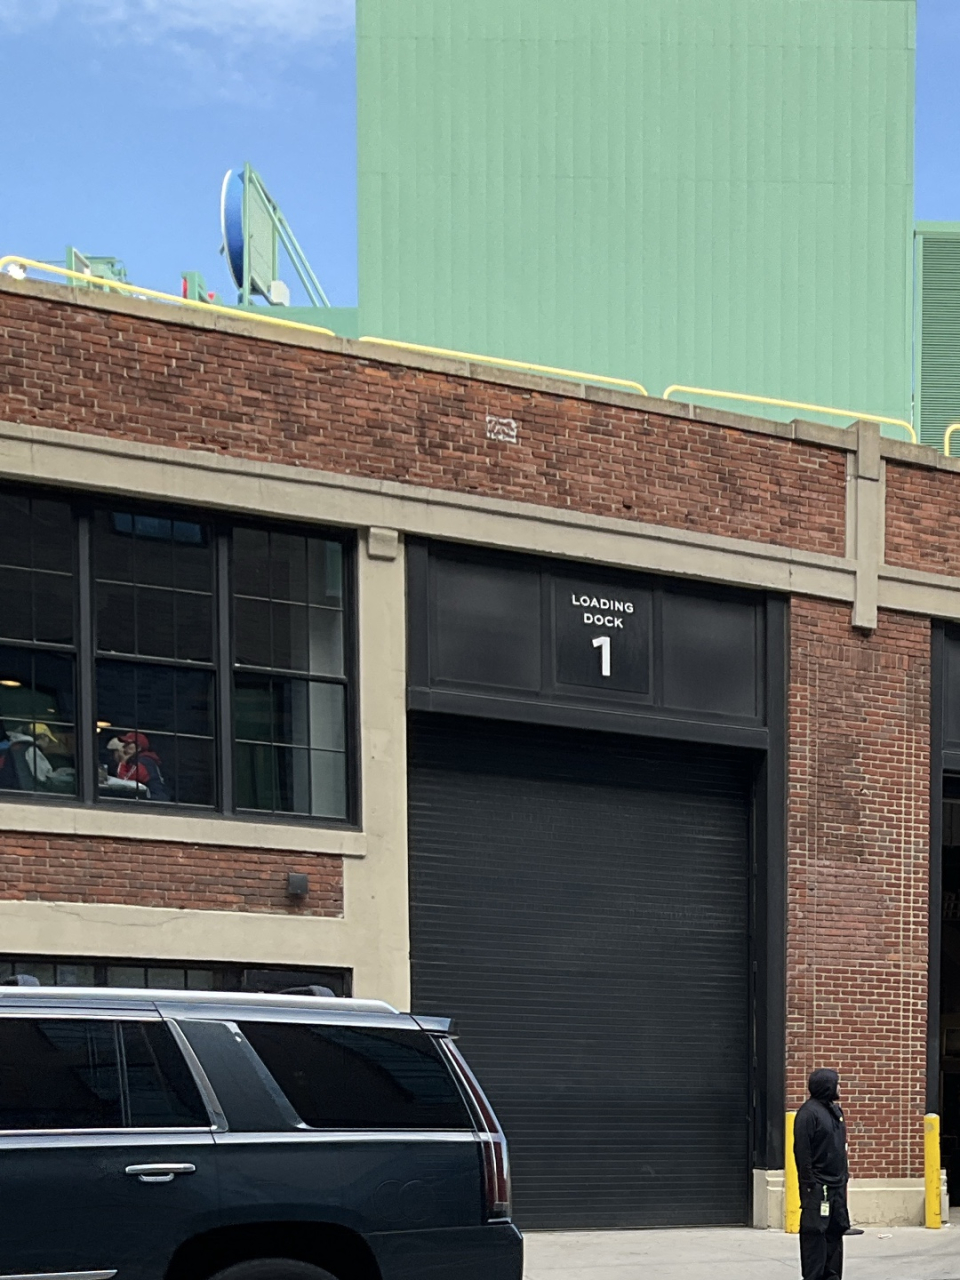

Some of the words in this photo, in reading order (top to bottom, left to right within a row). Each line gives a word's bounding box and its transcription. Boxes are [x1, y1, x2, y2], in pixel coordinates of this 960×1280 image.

[571, 594, 634, 613] LOADING
[583, 612, 624, 628] DOCK
[592, 636, 610, 676] 1
